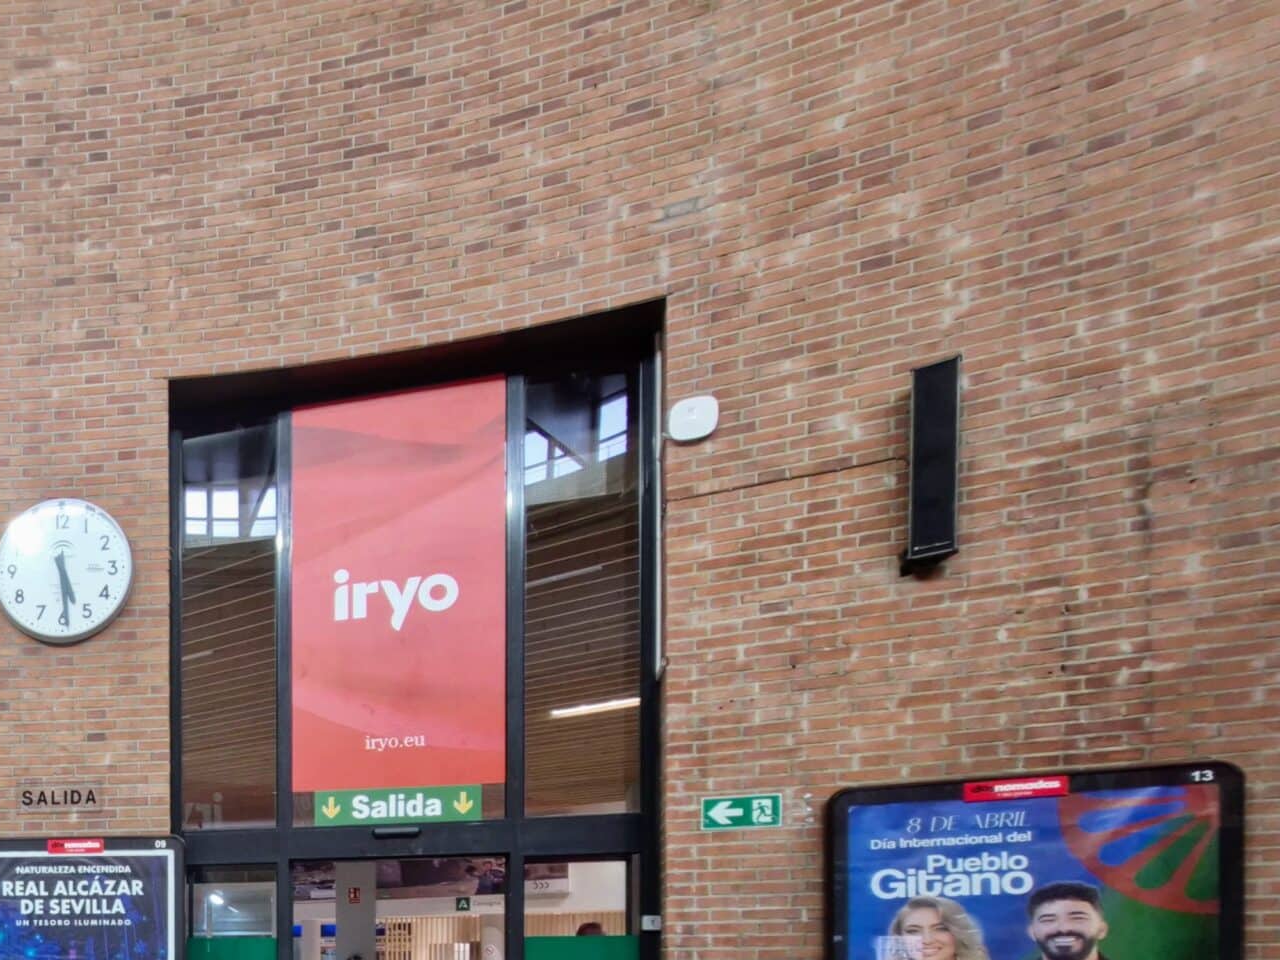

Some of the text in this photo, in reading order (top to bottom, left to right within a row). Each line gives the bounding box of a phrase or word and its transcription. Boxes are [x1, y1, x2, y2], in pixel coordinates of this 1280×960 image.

[55, 514, 70, 530] 12
[83, 518, 89, 534] 1
[100, 535, 111, 551] 2
[7, 564, 18, 579] 9
[107, 560, 119, 576] 3
[14, 589, 25, 604] 8
[99, 584, 111, 600] 4
[334, 569, 459, 631] iryo
[36, 605, 47, 620] 7
[58, 610, 70, 627] 6
[82, 603, 93, 619] 5
[365, 734, 425, 752] iryo.eu
[1191, 769, 1214, 782] 13
[22, 790, 97, 806] SALIDA
[351, 793, 442, 820] Salida
[906, 811, 1031, 833] 8 DE ABRIL
[154, 839, 167, 849] 09
[870, 830, 1032, 850] Día Internacional del
[15, 864, 132, 875] NATURALEZA ENCENDIDA
[926, 851, 1029, 873] Pueblo
[2, 876, 144, 897] REAL ALCÁZAR
[870, 866, 1034, 899] Gitano
[21, 898, 126, 915] DE SEVILLA
[16, 919, 30, 927] UN
